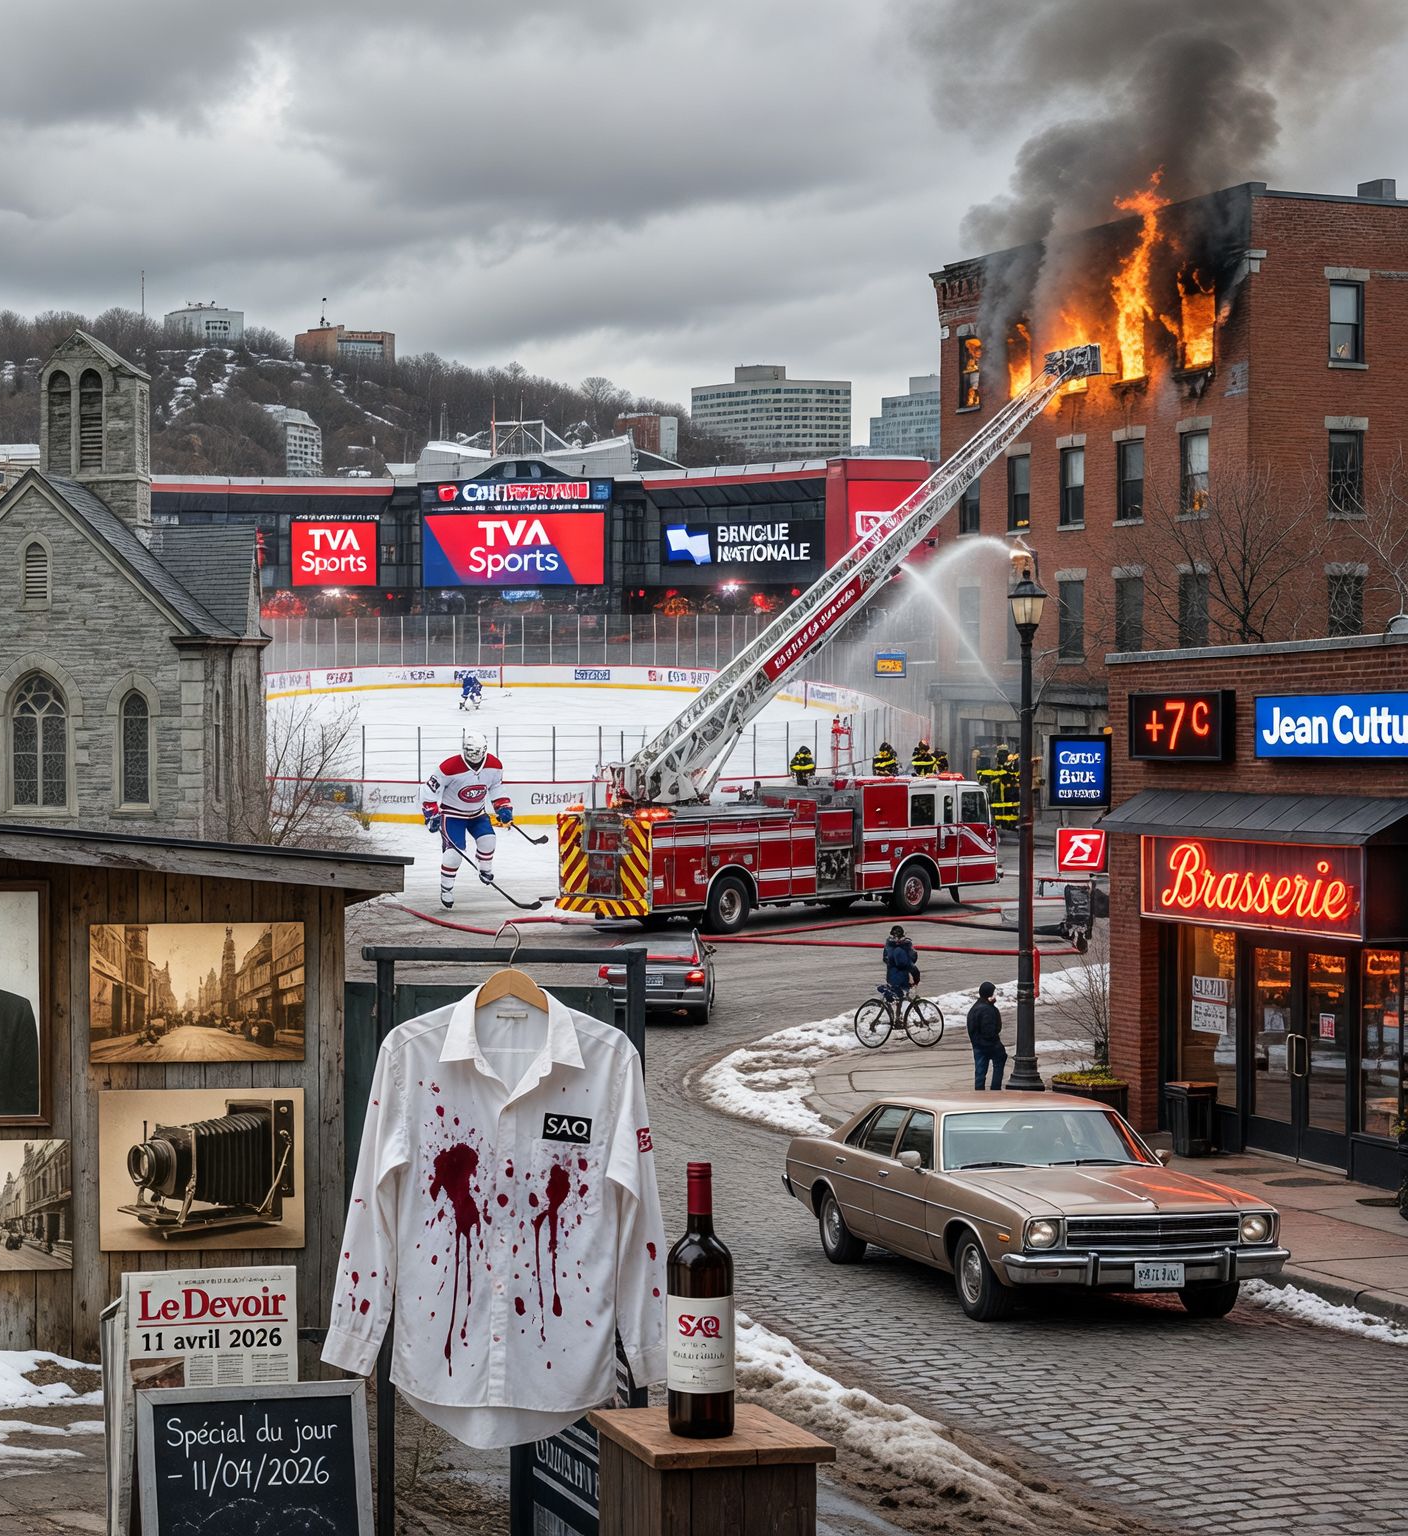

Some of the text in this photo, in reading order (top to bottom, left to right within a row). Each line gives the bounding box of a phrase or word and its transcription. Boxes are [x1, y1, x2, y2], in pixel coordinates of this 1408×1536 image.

[308, 528, 360, 551] TVA
[477, 519, 551, 547] TVA
[300, 550, 367, 576] Sports
[468, 546, 559, 579] Sports
[1262, 706, 1329, 745] Jean
[1161, 843, 1348, 920] Brasserie
[545, 1117, 589, 1141] SAQ
[138, 1286, 287, 1321] Le Devoir
[142, 1327, 282, 1352] 11 avril 2026
[166, 1413, 338, 1458] Spécial du jour
